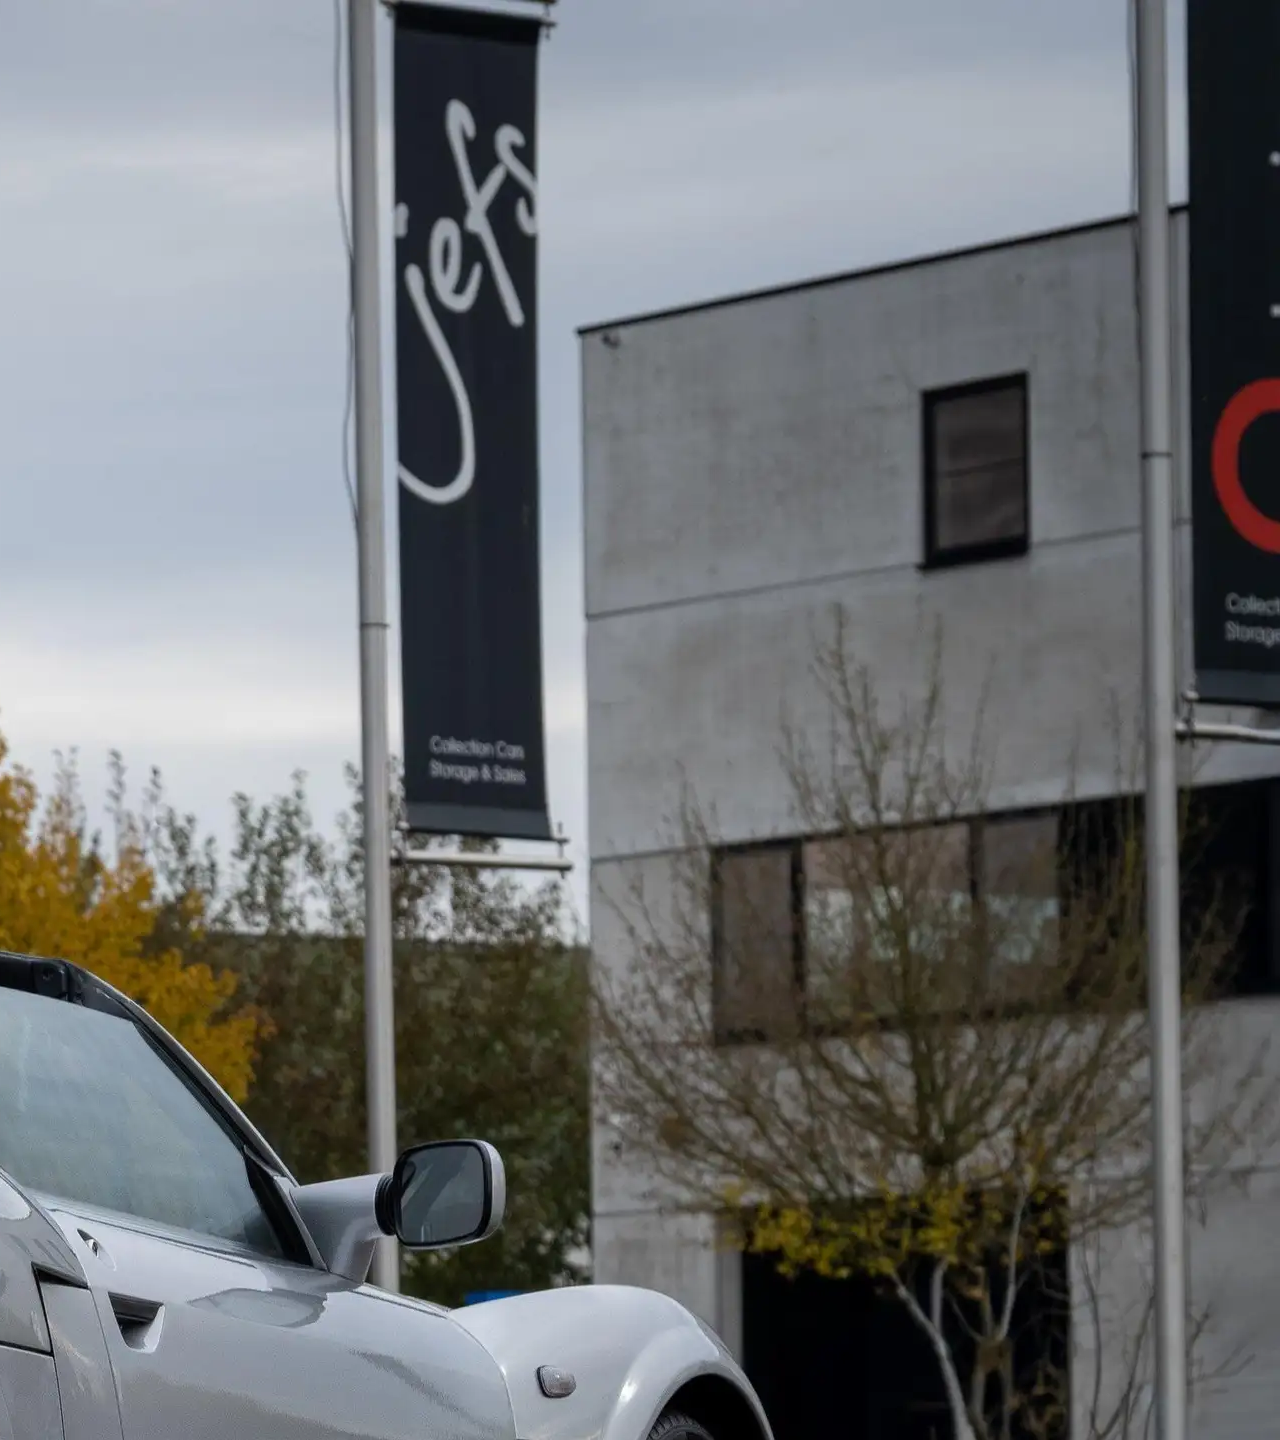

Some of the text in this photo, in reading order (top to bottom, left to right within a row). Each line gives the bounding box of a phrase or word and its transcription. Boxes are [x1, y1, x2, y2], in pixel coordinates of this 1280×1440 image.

[429, 735, 494, 758] Collection
[429, 758, 479, 784] Storage
[481, 763, 493, 782] &
